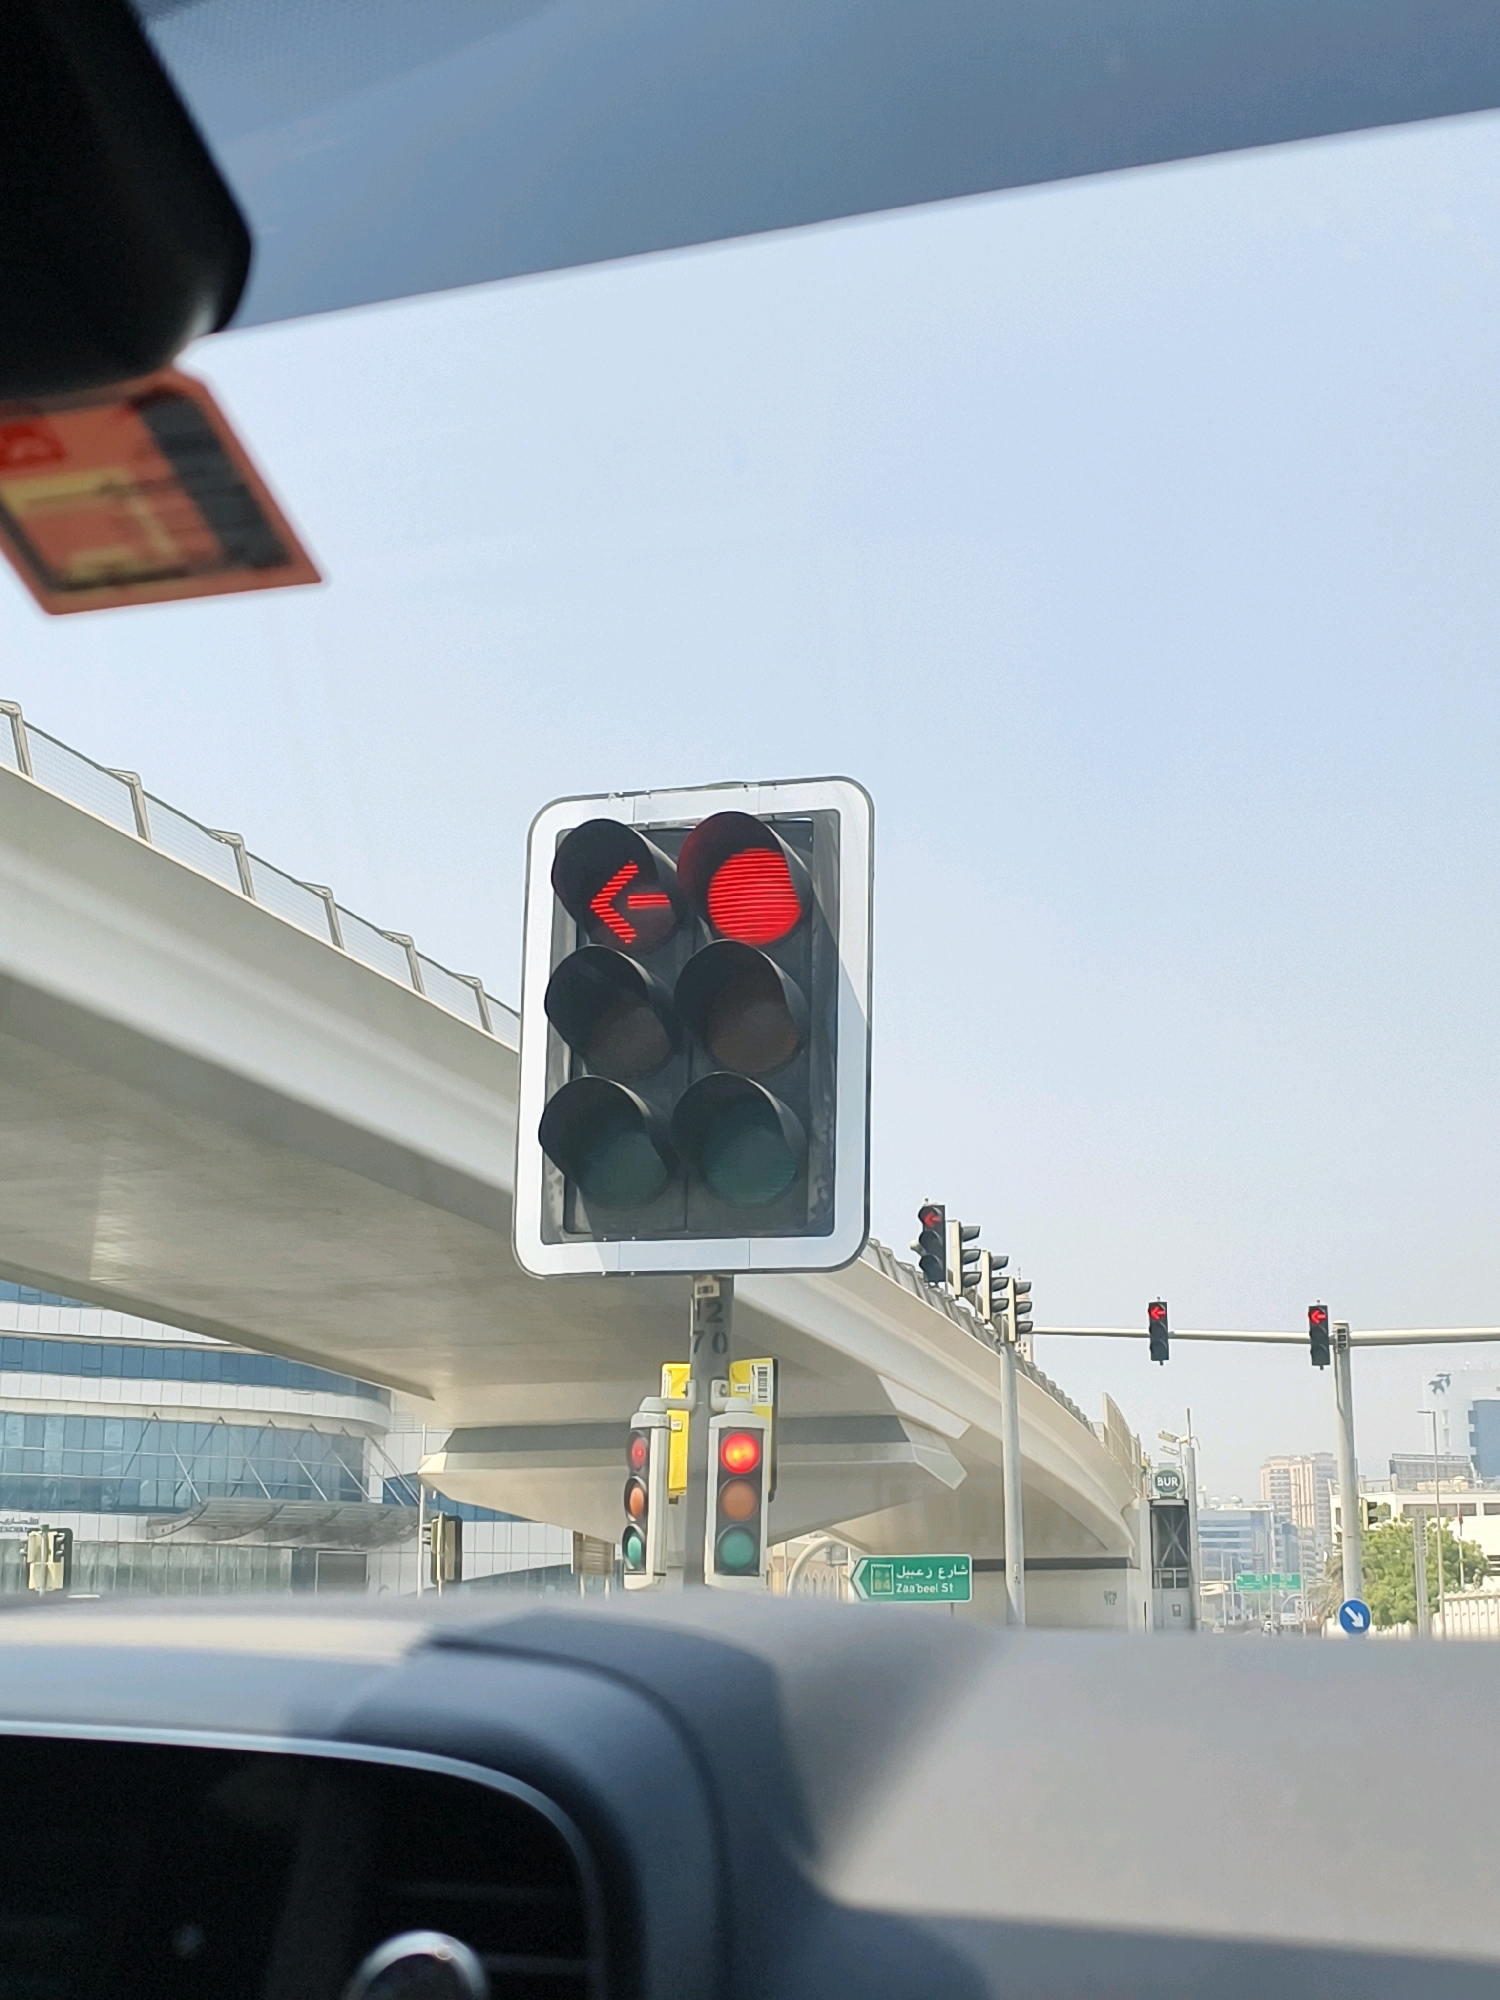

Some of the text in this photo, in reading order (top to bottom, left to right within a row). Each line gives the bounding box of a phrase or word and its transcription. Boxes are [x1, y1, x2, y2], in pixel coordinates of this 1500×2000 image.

[1157, 1476, 1179, 1487] BUR
[896, 1565, 933, 1580] زعبيل
[938, 1564, 969, 1580] شارع
[941, 1582, 954, 1594] St
